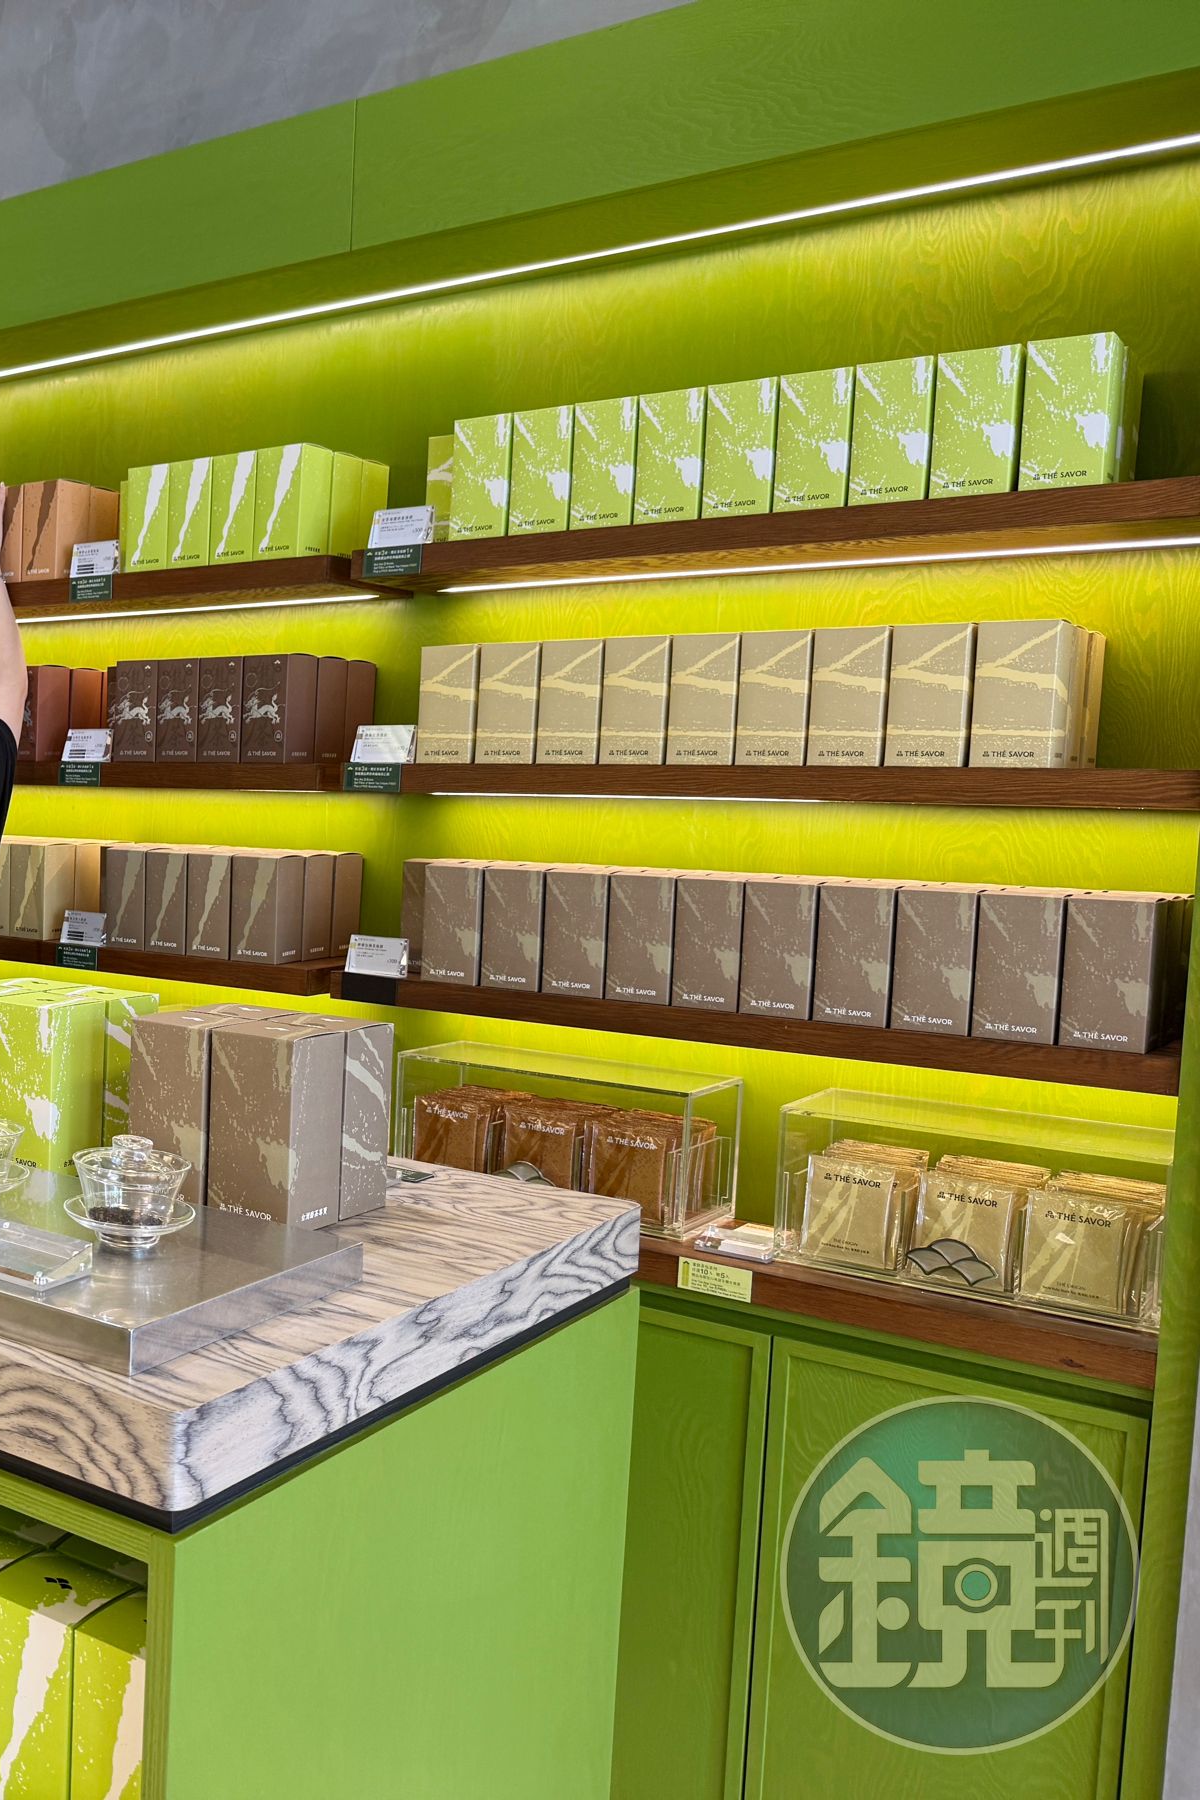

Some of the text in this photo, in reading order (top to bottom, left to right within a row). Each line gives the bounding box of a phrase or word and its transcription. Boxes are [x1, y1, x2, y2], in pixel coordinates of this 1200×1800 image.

[1060, 470, 1087, 479] SAVOR
[968, 478, 993, 486] SAVOR
[806, 493, 830, 501] SAVOR
[772, 1002, 794, 1010] SAVOR
[848, 1009, 872, 1018] SAVOR
[928, 1016, 953, 1026] SAVOR
[1011, 1025, 1037, 1034] SAVOR
[1100, 1033, 1128, 1043] SAVOR
[542, 1126, 565, 1136] SAVOR
[630, 1140, 656, 1150] SAVOR
[15, 1158, 37, 1168] SAVOR
[834, 1174, 881, 1188] THÉ SAVOR
[948, 1192, 998, 1208] THÉ SAVOR
[245, 1209, 272, 1221] SAVOR
[1057, 1212, 1111, 1228] THÉ SAVOR
